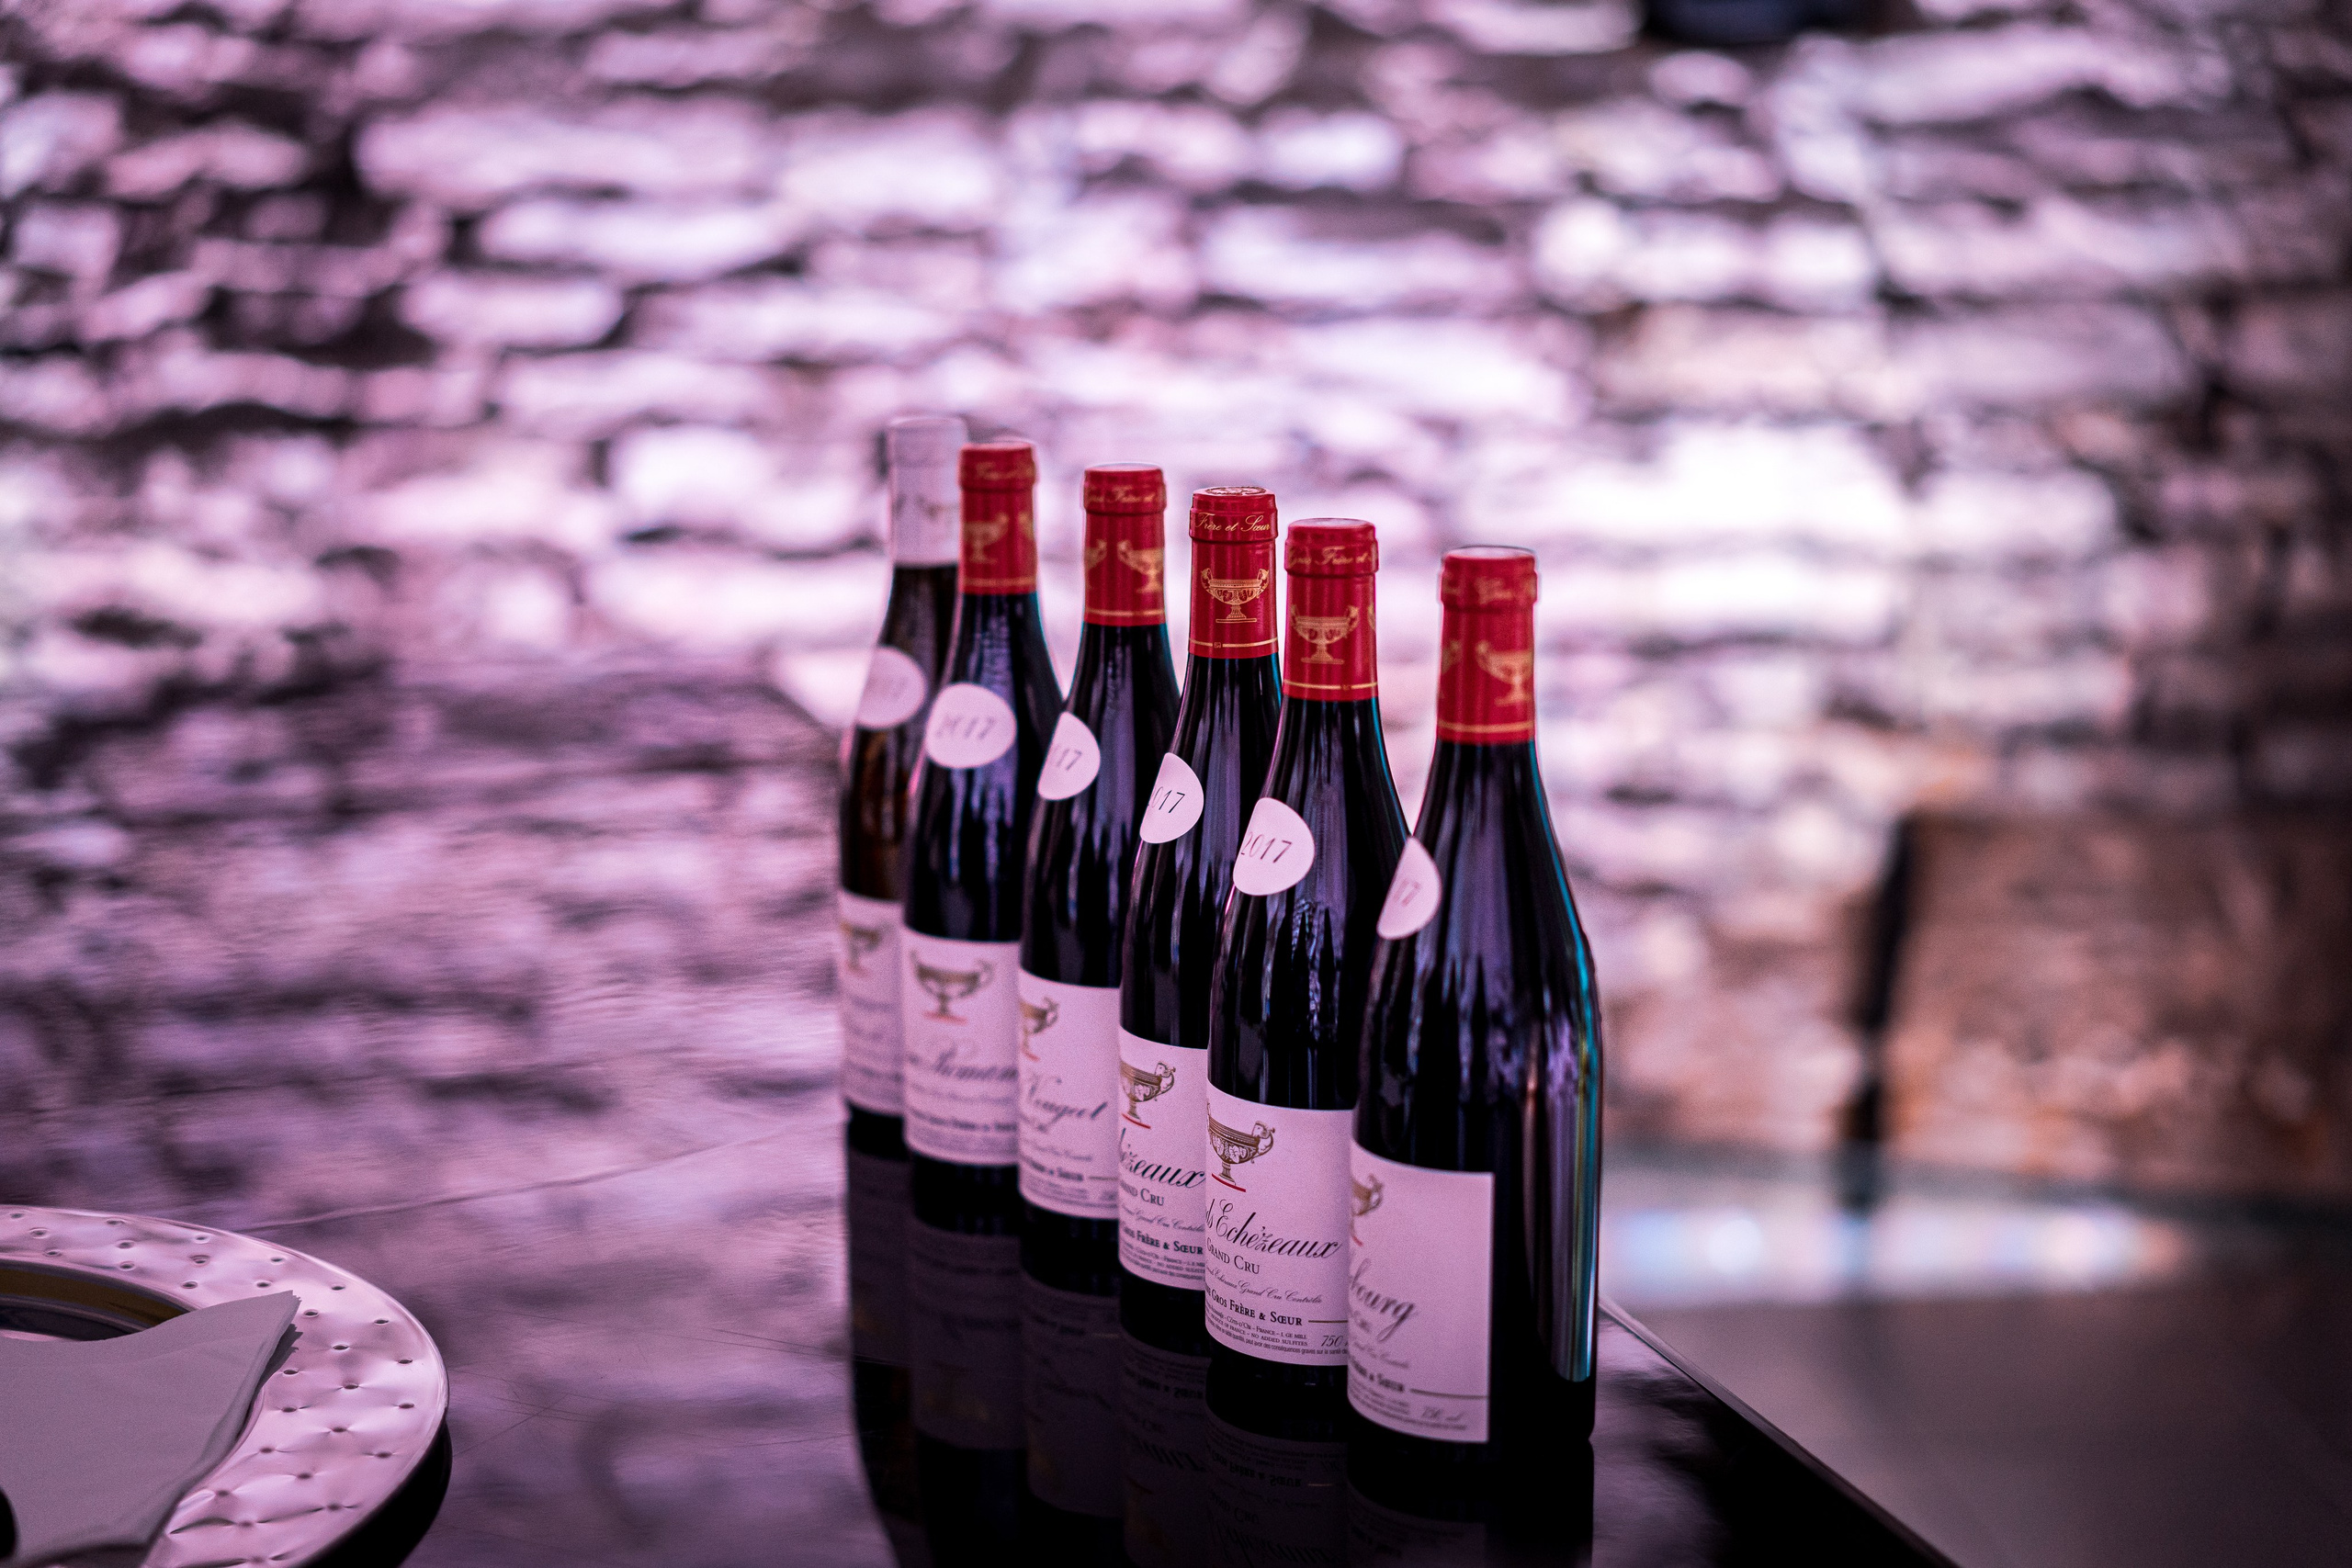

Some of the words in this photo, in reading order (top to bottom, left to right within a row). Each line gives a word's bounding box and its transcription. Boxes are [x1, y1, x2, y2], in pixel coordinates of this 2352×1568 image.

[1195, 512, 1222, 531] Frère
[1225, 522, 1239, 532] et
[1240, 514, 1270, 532] Sœur
[1240, 830, 1294, 863] 2017
[1140, 1188, 1165, 1206] CRU
[1173, 1240, 1204, 1255] SŒUR
[1206, 1237, 1230, 1264] GRAND
[1234, 1255, 1261, 1275] CRU
[1212, 1289, 1227, 1308] GROS
[1229, 1299, 1256, 1318] FRÈRE
[1259, 1312, 1266, 1321] &
[1270, 1311, 1303, 1326] SŒUR
[1261, 1336, 1281, 1344] ADDED
[1321, 1335, 1344, 1348] 750
